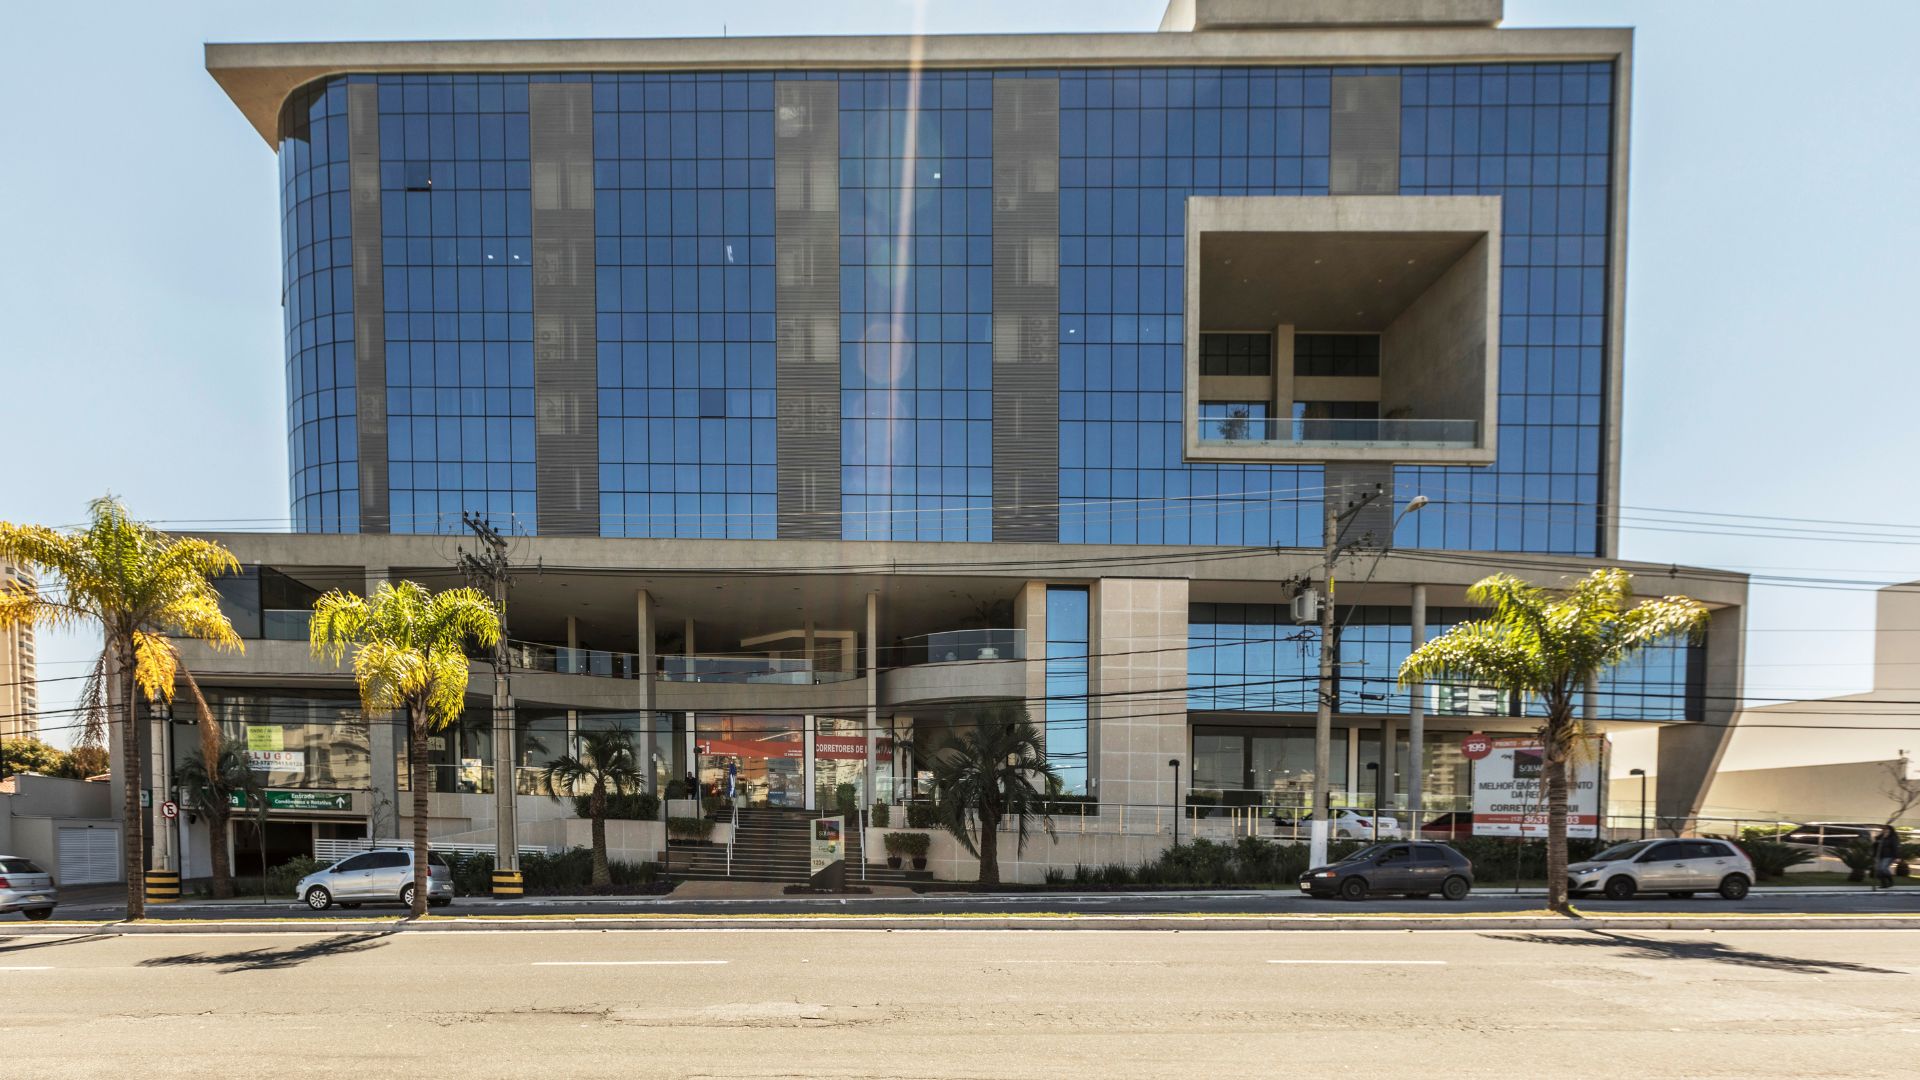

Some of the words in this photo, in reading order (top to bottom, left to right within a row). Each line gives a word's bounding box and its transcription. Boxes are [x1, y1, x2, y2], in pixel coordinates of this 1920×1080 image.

[816, 744, 855, 753] CORRETORES
[856, 745, 864, 753] DE
[1468, 743, 1486, 752] 199
[1479, 782, 1514, 790] MELHOR
